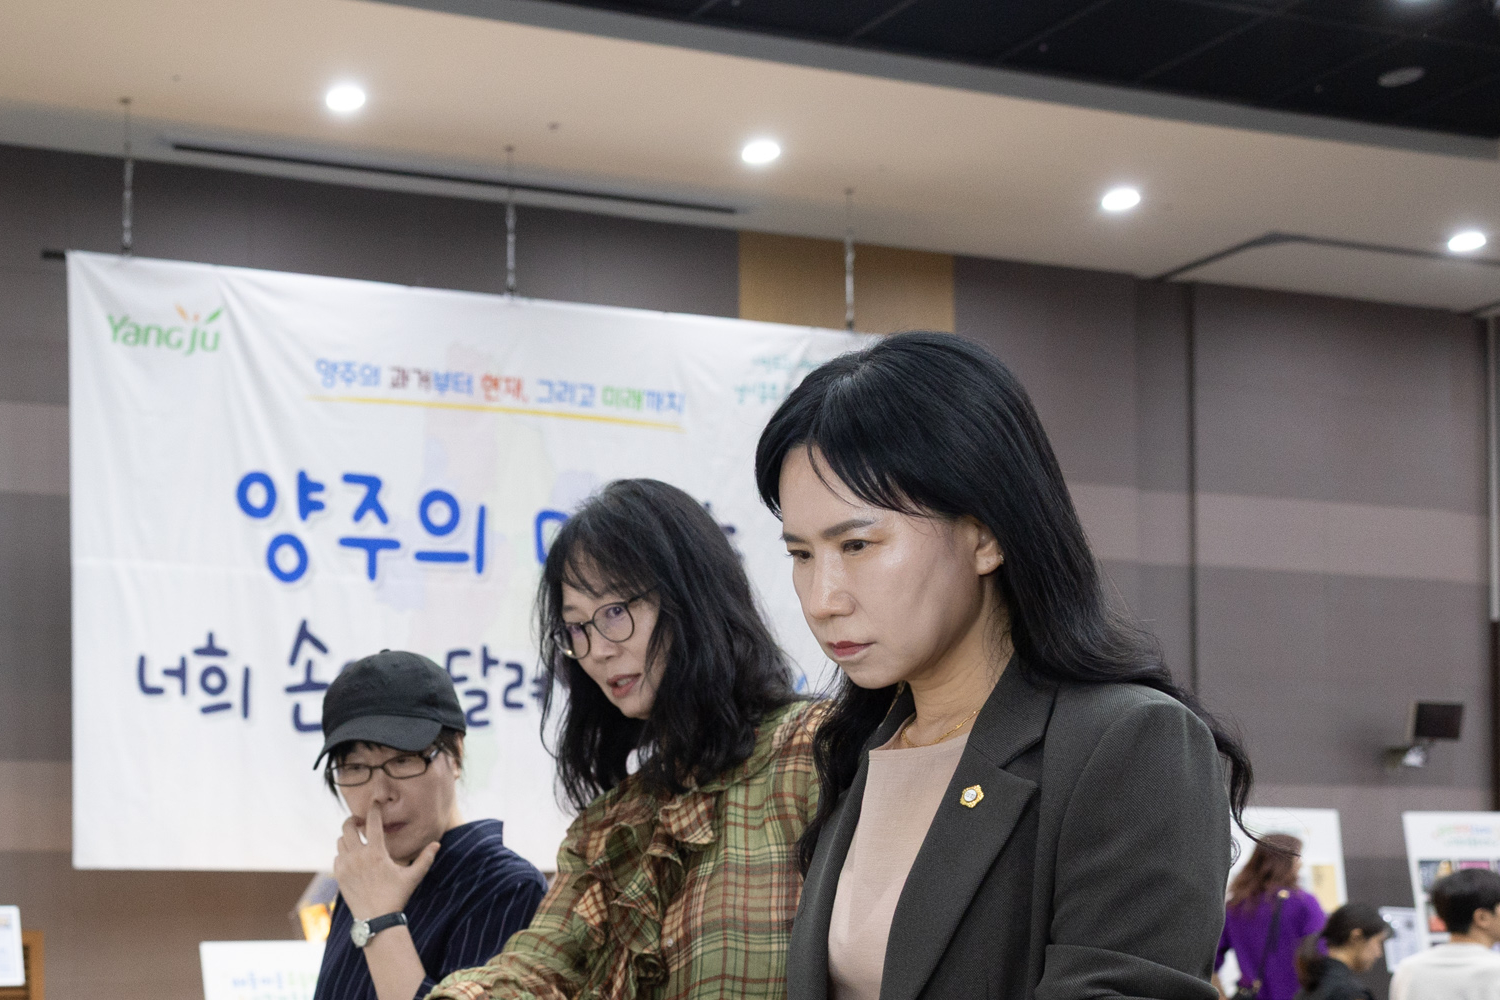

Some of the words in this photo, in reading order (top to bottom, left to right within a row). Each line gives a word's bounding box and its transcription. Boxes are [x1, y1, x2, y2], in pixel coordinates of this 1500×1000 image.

[315, 358, 382, 389] 양주의
[390, 366, 475, 397] 과거부터
[536, 378, 596, 408] 그리고
[602, 384, 686, 415] 미래까지
[237, 470, 487, 583] 양주의
[138, 631, 252, 720] 너희
[285, 618, 357, 733] 손
